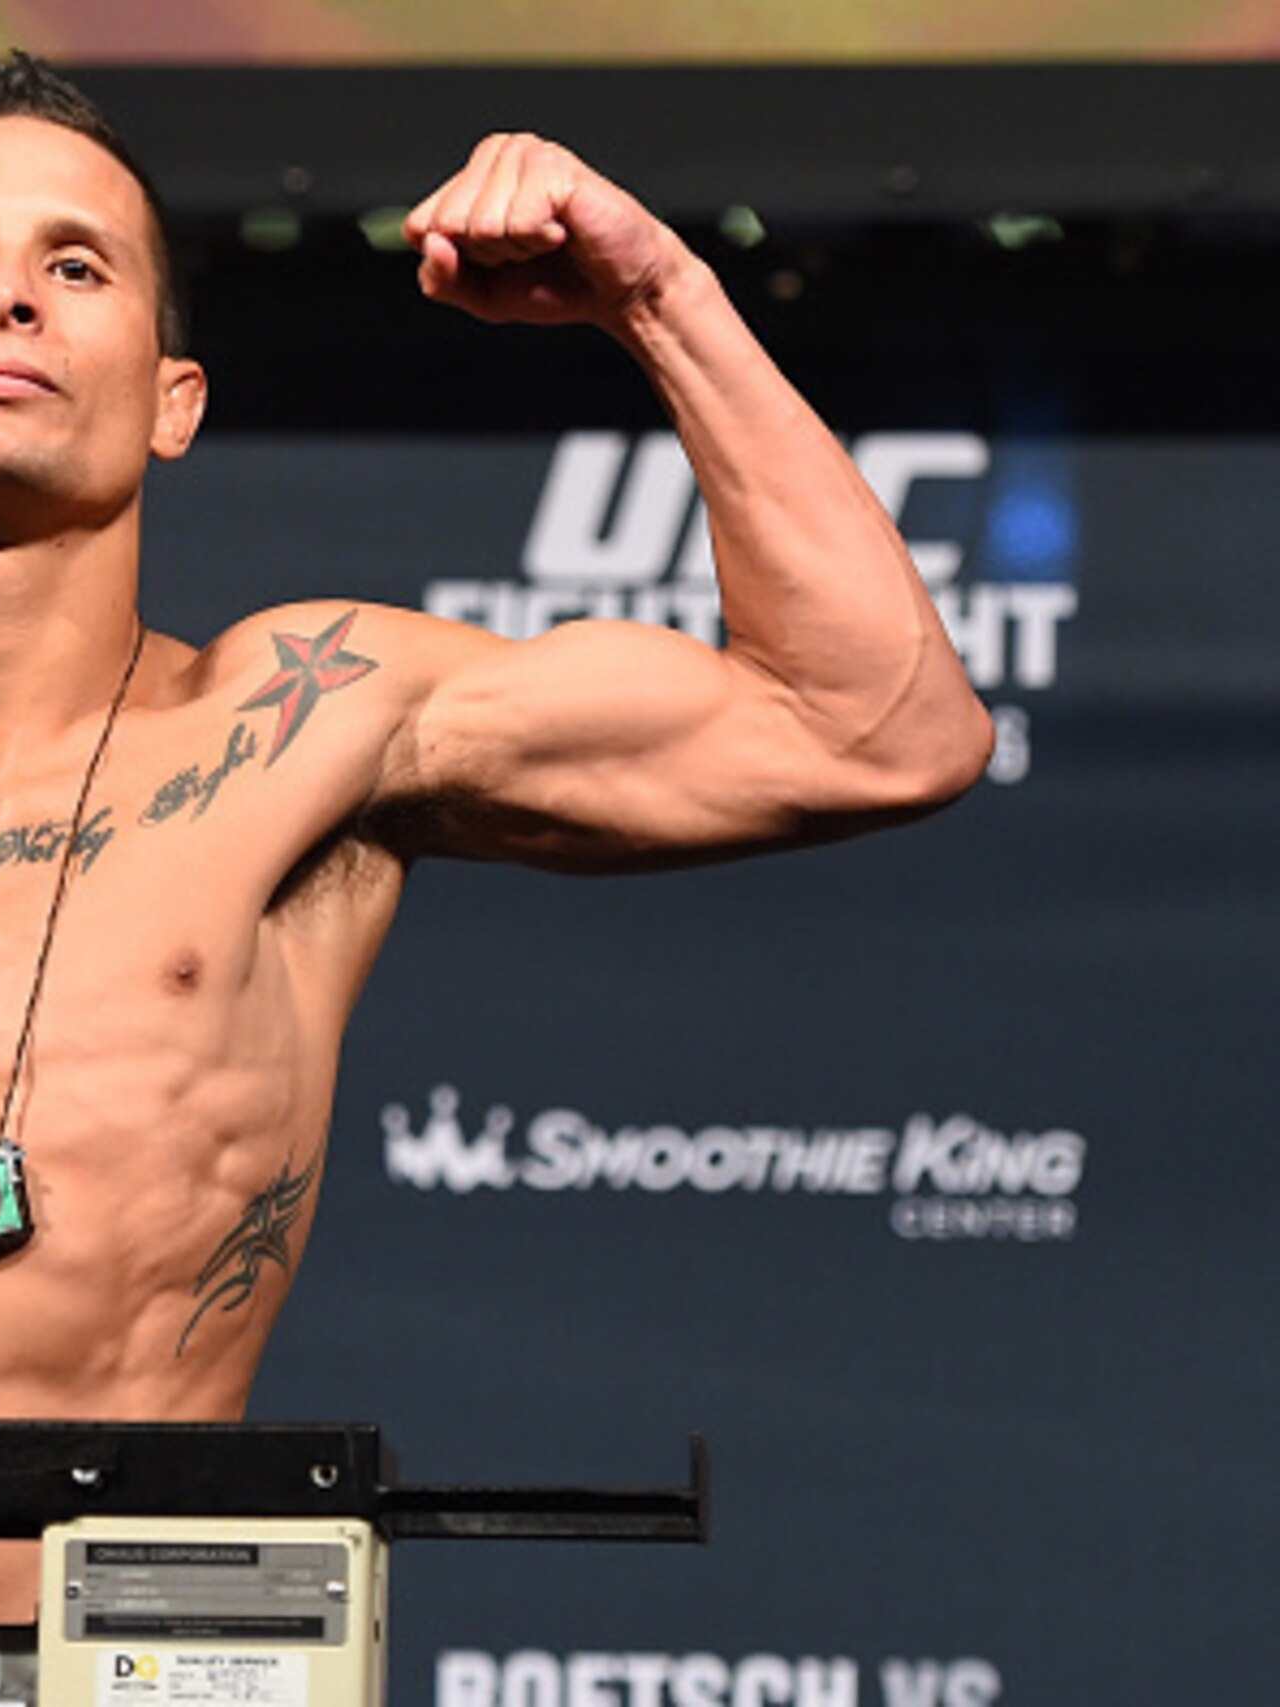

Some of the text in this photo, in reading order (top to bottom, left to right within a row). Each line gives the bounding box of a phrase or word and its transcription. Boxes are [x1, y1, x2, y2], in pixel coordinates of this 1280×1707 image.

[520, 1108, 1087, 1197] SMOOTHIE KING
[890, 1198, 1078, 1242] CENTER
